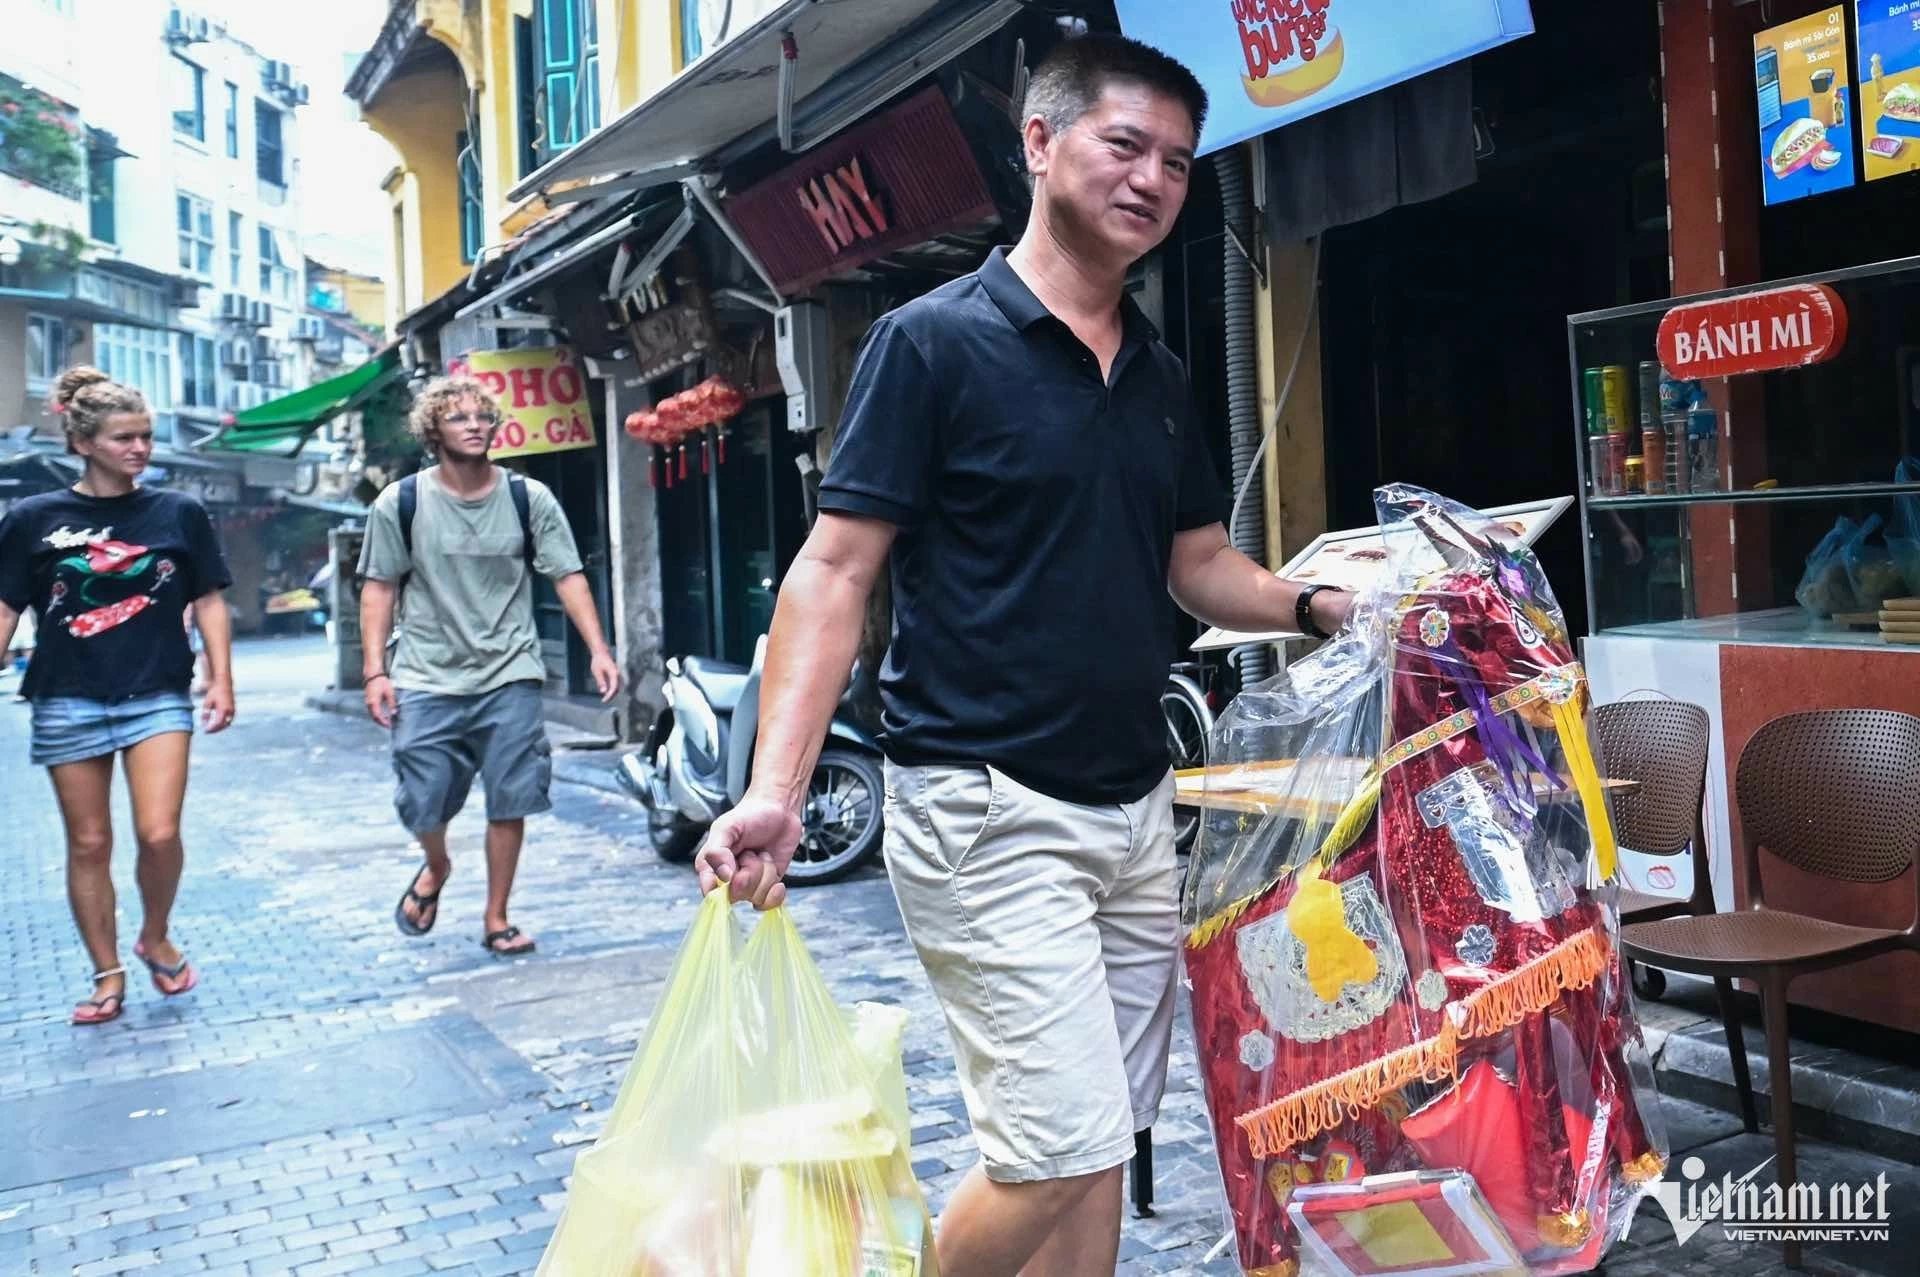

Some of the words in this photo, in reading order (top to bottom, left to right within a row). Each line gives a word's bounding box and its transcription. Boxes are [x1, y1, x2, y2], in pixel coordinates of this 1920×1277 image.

[1828, 11, 1839, 25] 01
[1888, 2, 1909, 17] Bánh
[1238, 11, 1327, 81] burger
[797, 156, 888, 256] HAY
[1674, 318, 1762, 365] BÁNH
[1771, 303, 1813, 351] MÌ
[491, 413, 526, 449] Ò
[544, 408, 592, 444] GÀ
